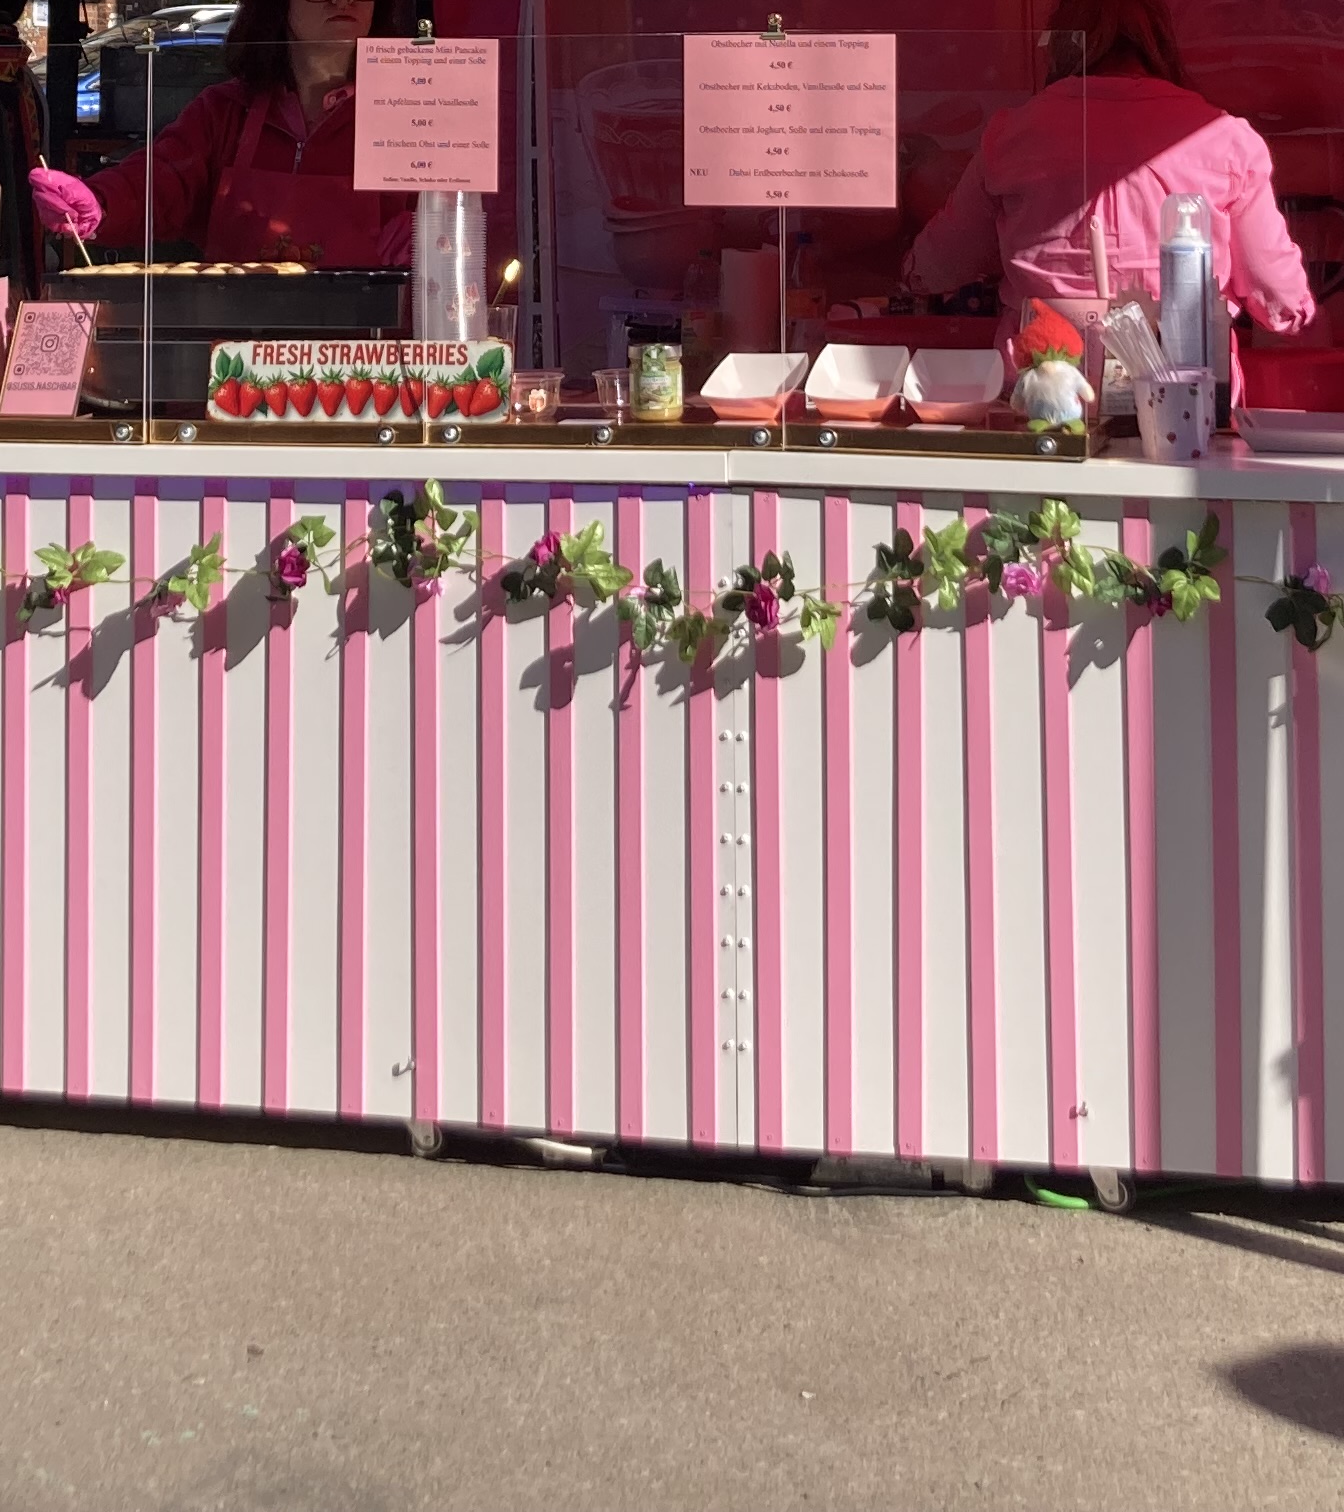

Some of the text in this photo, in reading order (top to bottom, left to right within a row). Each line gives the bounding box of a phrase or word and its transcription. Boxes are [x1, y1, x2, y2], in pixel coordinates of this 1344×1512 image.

[710, 39, 870, 49] Obstbecher mit Nutella und einem Topping
[365, 45, 487, 56] 10 frisch gebackene Mini Pancakes
[367, 56, 379, 64] mit
[380, 57, 402, 65] einem
[404, 56, 432, 66] Topping
[433, 56, 448, 64] und
[468, 56, 487, 65] Soße
[769, 61, 793, 70] 4,50 €
[427, 77, 433, 85] €
[699, 82, 887, 92] Obstbecher mit Keksboden, Vanillesoße und Sahne
[373, 98, 479, 108] mit Apfelmus und Vanillesoße
[767, 104, 792, 113] 4,50 €
[411, 119, 434, 128] 5,00 €
[699, 125, 741, 134] Obstbecher
[742, 125, 755, 134] mit
[756, 125, 787, 136] Joghurt,
[788, 125, 808, 134] Soße
[809, 126, 824, 134] und
[850, 125, 881, 136] Topping
[372, 139, 490, 150] mit frischem Obst und einer Soße
[765, 147, 790, 156] 4,50 €
[427, 161, 433, 169] €
[689, 168, 869, 178] NEU Dubai Erdbeerbecher mit Schokosoße
[765, 190, 790, 199] 5,50 €
[252, 340, 469, 367] FRESH STRAWBERRIES
[6, 381, 78, 392] @SUSIS.NASCHBAR
